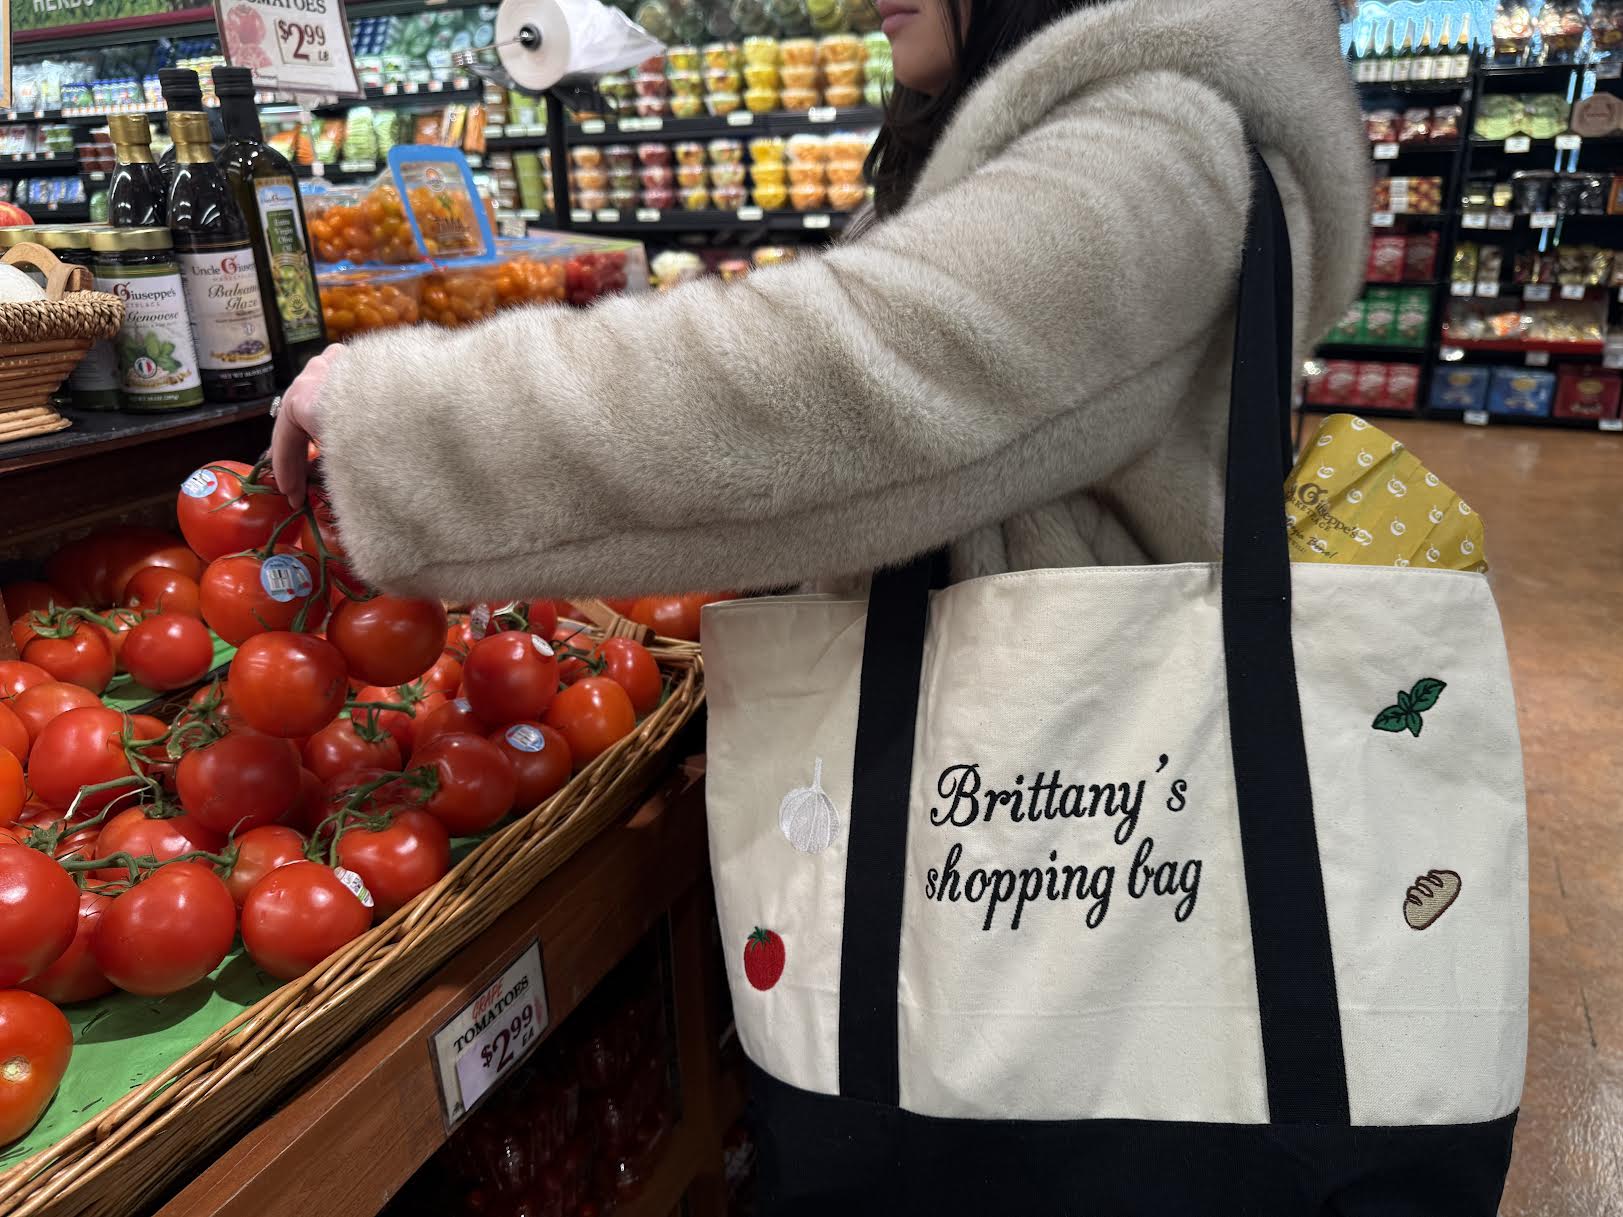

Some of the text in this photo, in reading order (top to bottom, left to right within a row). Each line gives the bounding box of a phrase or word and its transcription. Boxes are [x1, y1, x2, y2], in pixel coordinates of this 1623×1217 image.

[240, 0, 327, 14] ATOES
[192, 265, 221, 276] Uncle
[930, 754, 1187, 845] Brittany's
[925, 836, 1202, 931] shopping bag
[453, 975, 530, 1054] TOMATOES
[521, 1026, 535, 1048] EA
